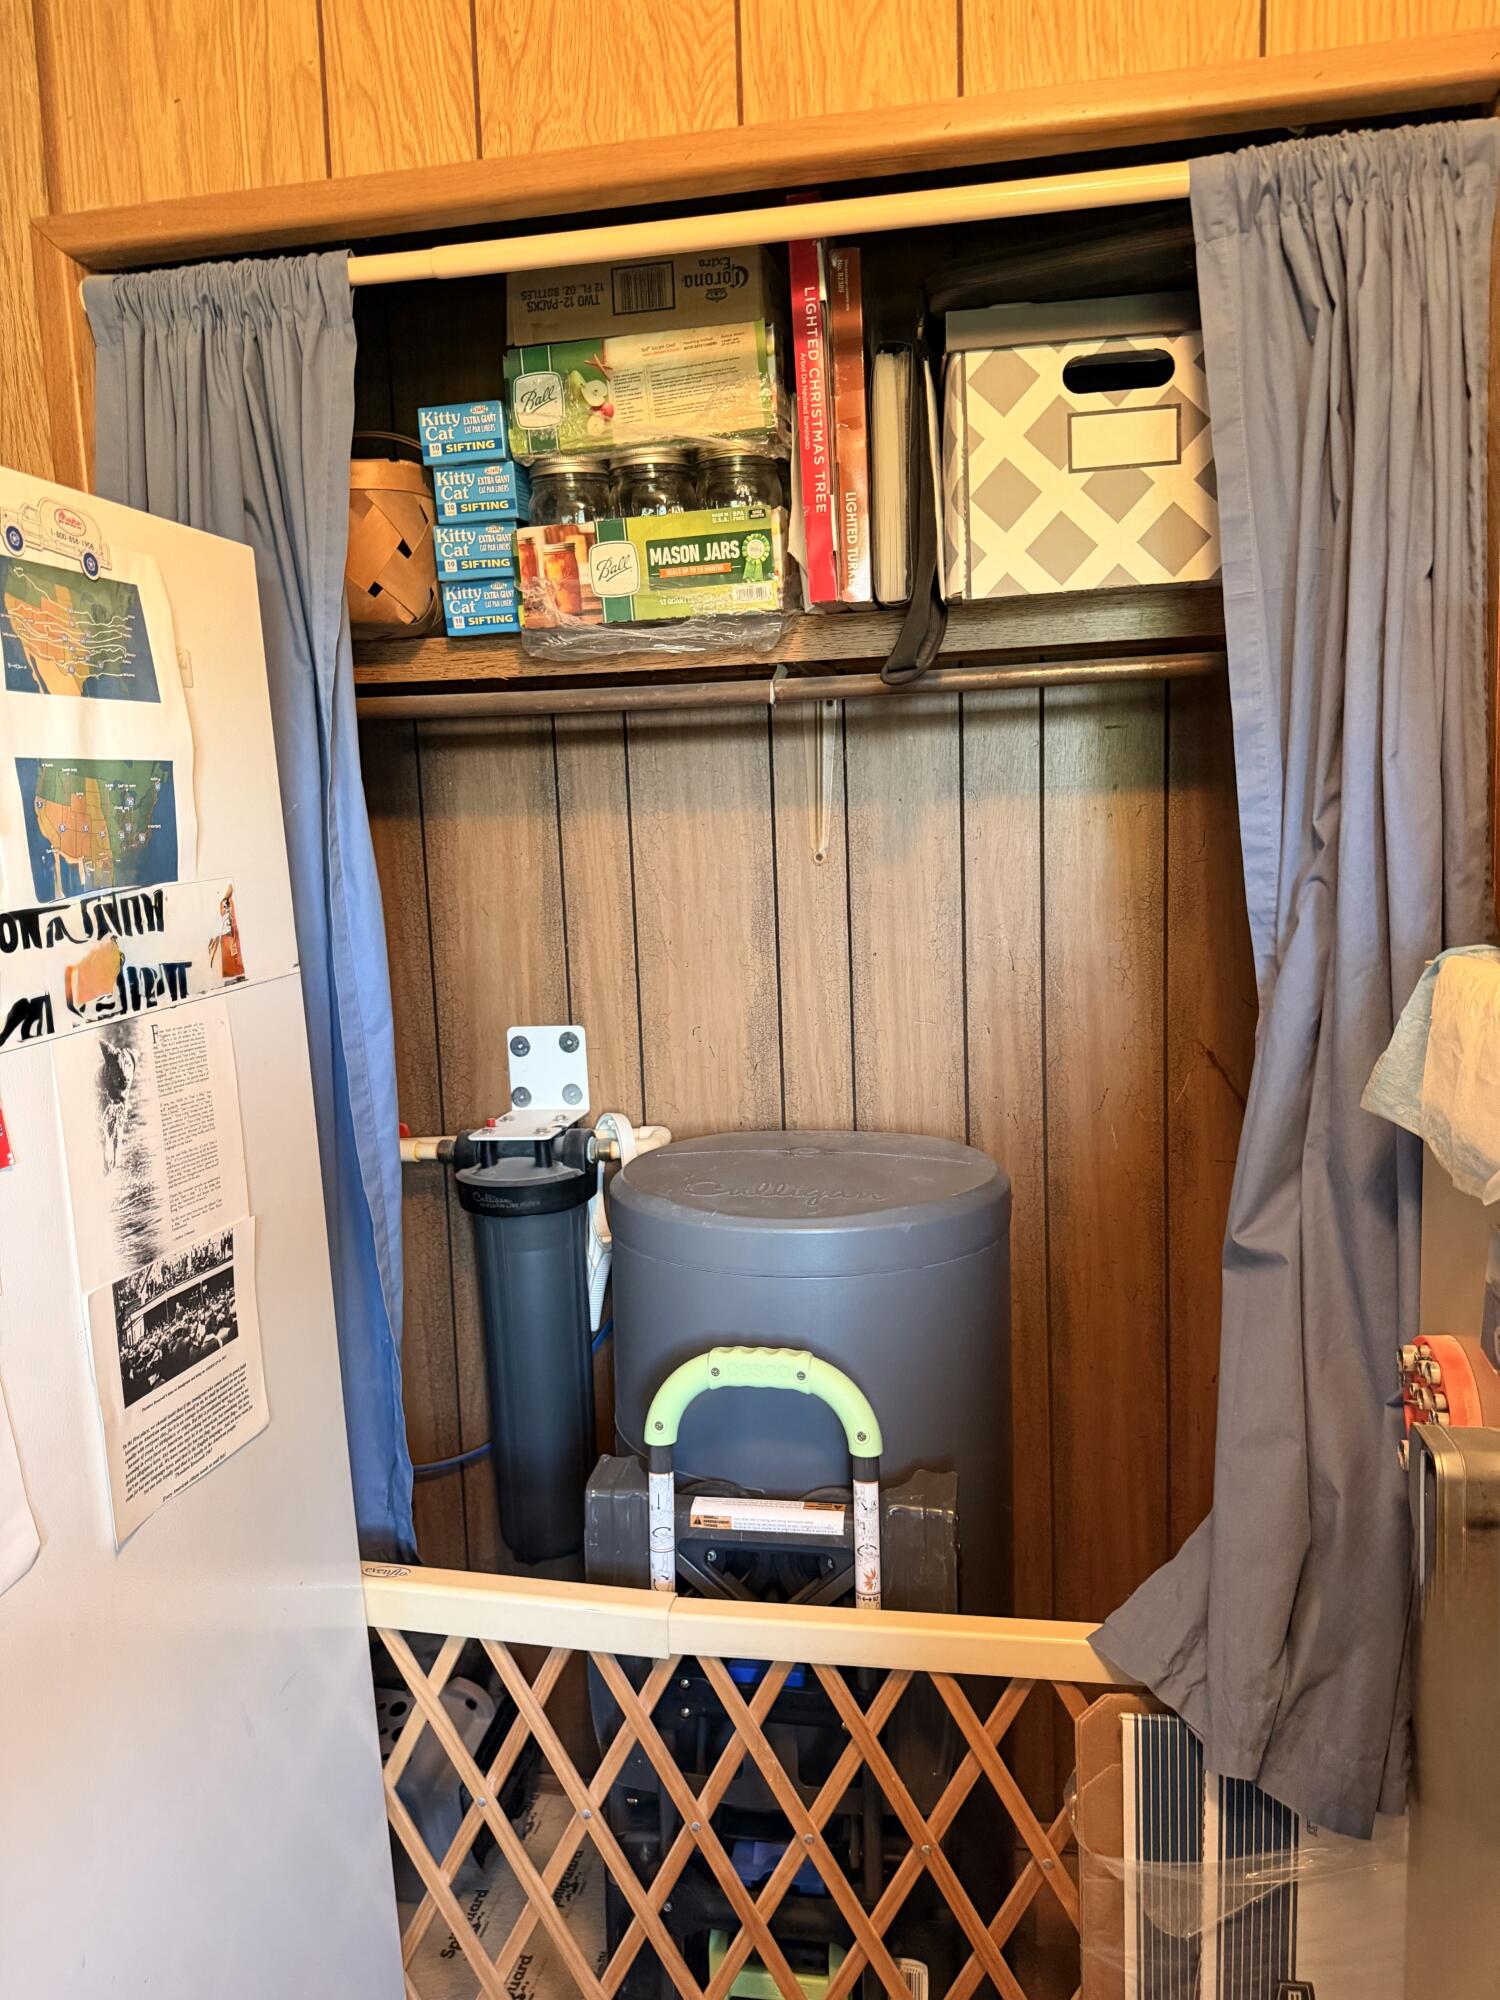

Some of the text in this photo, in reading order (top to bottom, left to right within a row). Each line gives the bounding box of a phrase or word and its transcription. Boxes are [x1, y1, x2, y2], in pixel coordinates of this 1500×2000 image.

[699, 256, 731, 269] Extra
[682, 265, 749, 289] Corona
[521, 288, 560, 300] BOTTLES
[563, 286, 577, 296] OZ.
[594, 282, 604, 292] 12
[527, 294, 601, 313] TWO 12-PACKS
[520, 385, 556, 414] Ball
[804, 286, 827, 513] LIGHTED CHRISTMAS TREE
[421, 411, 460, 427] Kitty
[463, 415, 480, 425] EXTRA
[425, 426, 454, 440] Cat
[446, 440, 495, 452] SIFTING
[436, 471, 475, 488] Kitty
[478, 476, 494, 485] EXTRA
[440, 486, 469, 500] Cat
[461, 500, 509, 512] SIFTING
[845, 491, 858, 544] LIGHTED
[436, 528, 476, 545] Kitty
[478, 535, 495, 543] EXTRA
[440, 543, 470, 558] Cat
[649, 540, 741, 566] MASON JARS
[461, 558, 510, 569] SIFTING
[597, 555, 632, 584] Ball
[445, 587, 482, 602] Kitty
[483, 591, 499, 600] EXTRA
[449, 601, 476, 614] Cat
[468, 614, 513, 625] SIFTING
[685, 1181, 886, 1207] Culligan
[727, 1363, 791, 1378] COSCO
[364, 1567, 409, 1577] evenflo
